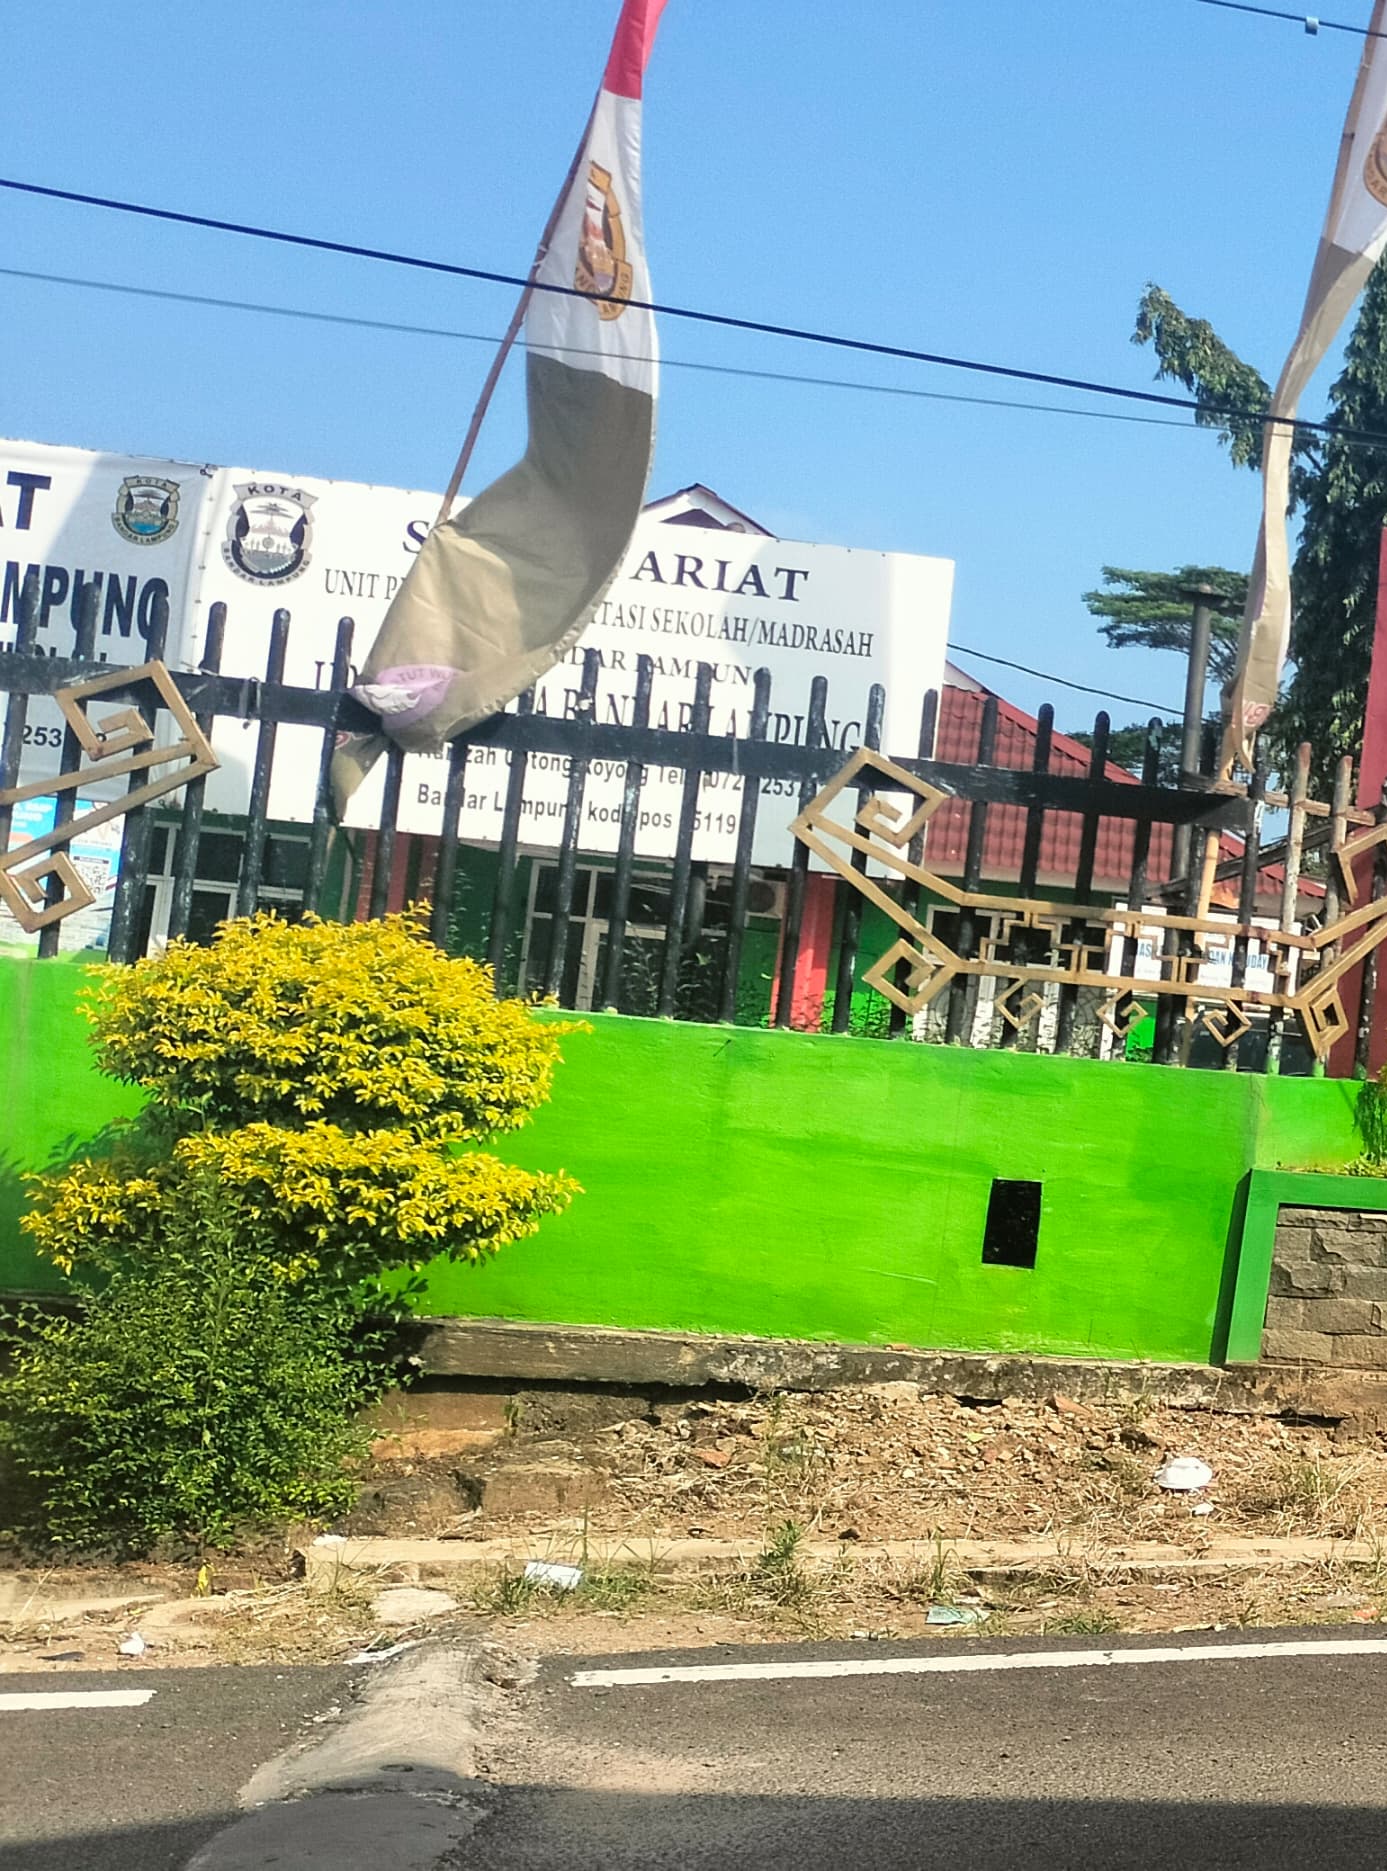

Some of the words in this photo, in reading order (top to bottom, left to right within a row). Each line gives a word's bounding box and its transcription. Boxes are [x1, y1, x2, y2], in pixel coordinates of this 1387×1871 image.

[0, 471, 52, 530] T
[247, 485, 302, 501] KOTA
[324, 568, 379, 599] UNIT
[650, 606, 874, 657] SEKOLAH/MADRASAH
